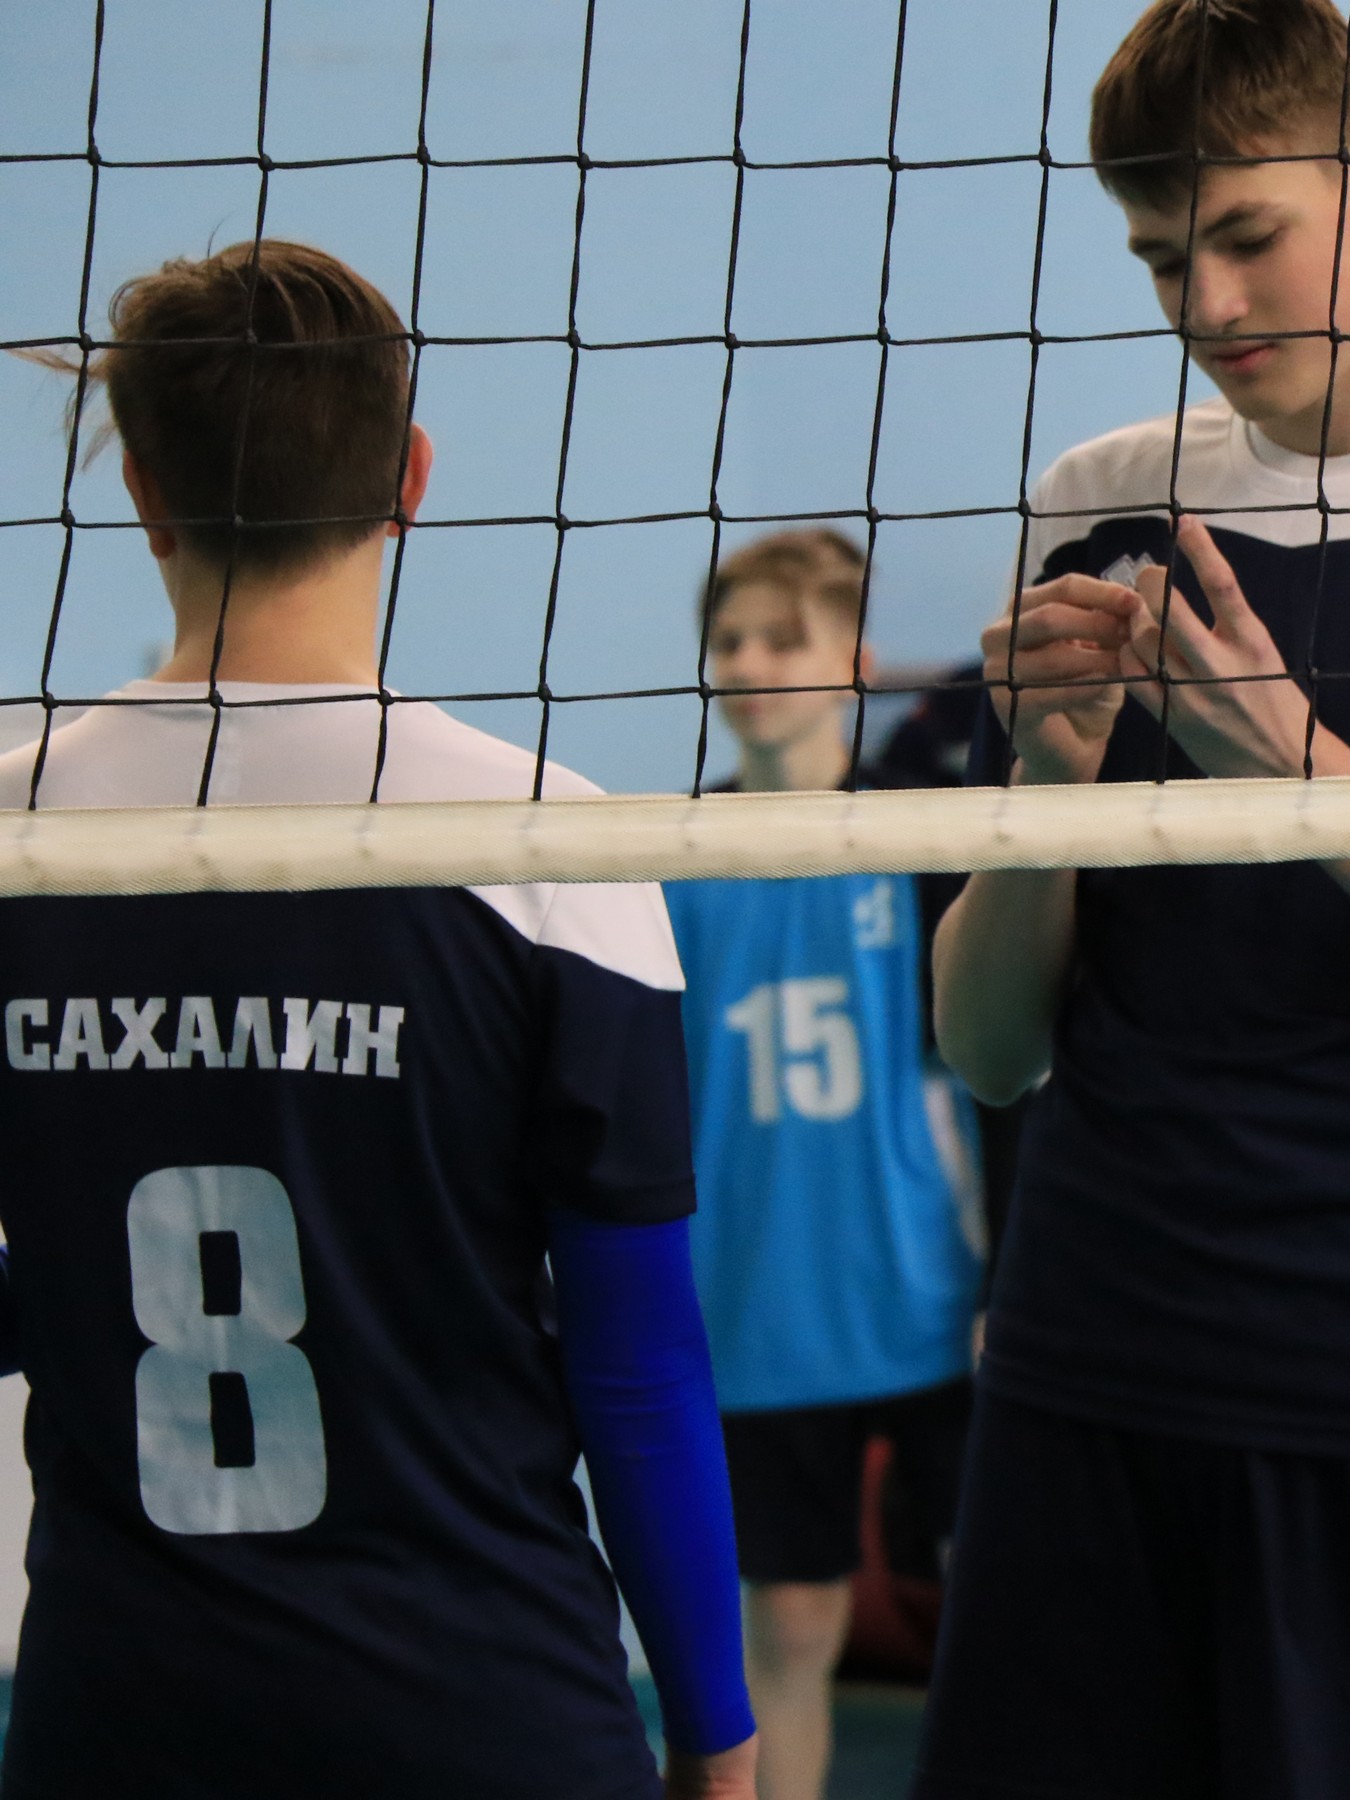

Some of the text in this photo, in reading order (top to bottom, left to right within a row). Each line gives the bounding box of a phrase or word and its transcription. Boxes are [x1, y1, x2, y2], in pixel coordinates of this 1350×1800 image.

[4, 997, 405, 1078] САХАЛИН
[724, 974, 862, 1124] 15
[127, 1165, 327, 1536] 8
